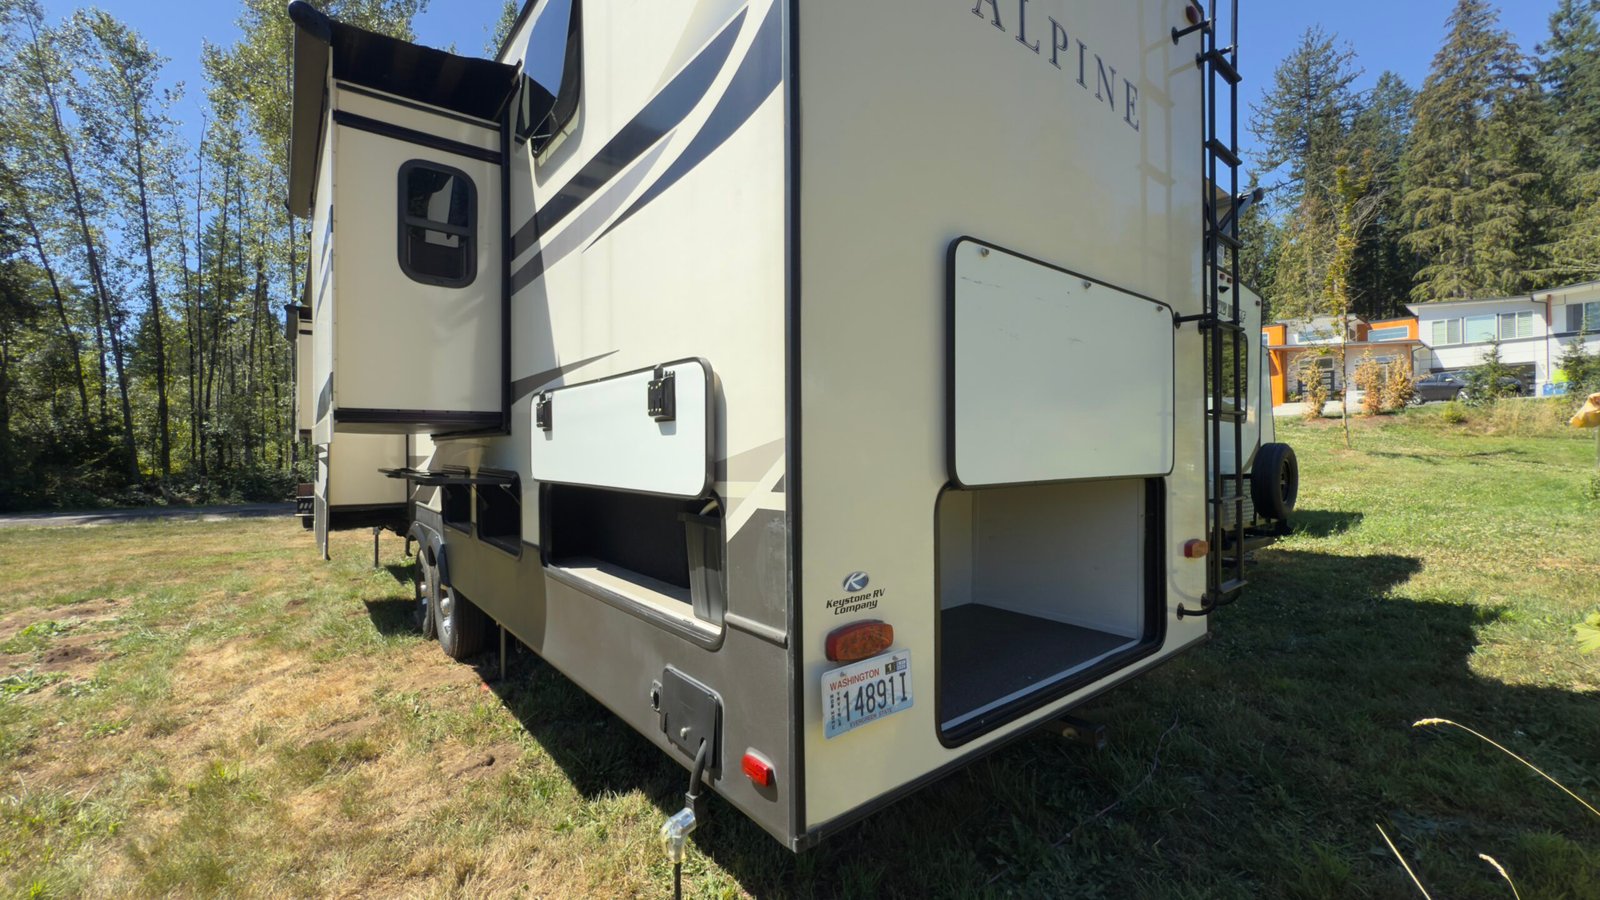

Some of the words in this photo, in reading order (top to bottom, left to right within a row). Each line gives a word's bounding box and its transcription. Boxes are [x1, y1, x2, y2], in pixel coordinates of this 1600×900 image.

[826, 593, 872, 609] Keystone
[872, 588, 886, 598] RV
[834, 600, 878, 615] Company
[829, 668, 880, 691] WASHINGTON
